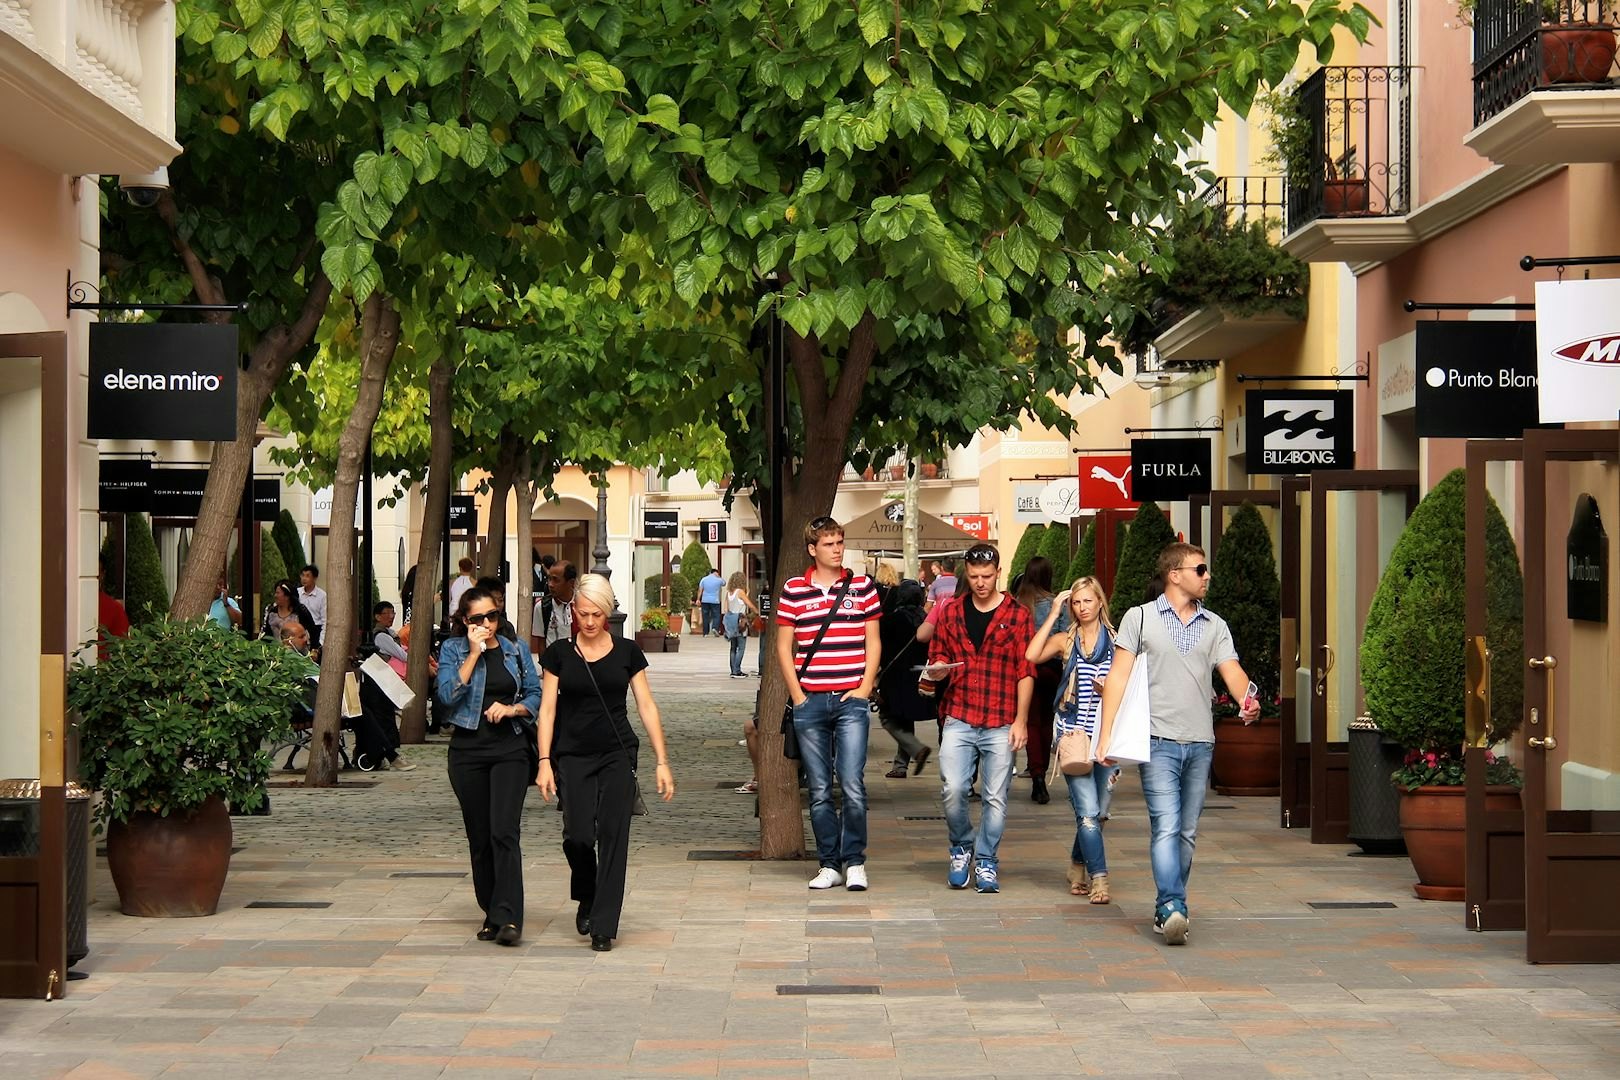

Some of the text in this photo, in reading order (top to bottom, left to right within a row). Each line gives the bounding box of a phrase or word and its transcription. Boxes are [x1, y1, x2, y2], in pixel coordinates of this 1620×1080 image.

[1579, 339, 1620, 361] M
[103, 368, 166, 390] elena
[1449, 367, 1538, 387] Punto Blan
[1141, 463, 1201, 477] FURLA
[1017, 496, 1034, 509] Café
[868, 519, 924, 534] Amoro
